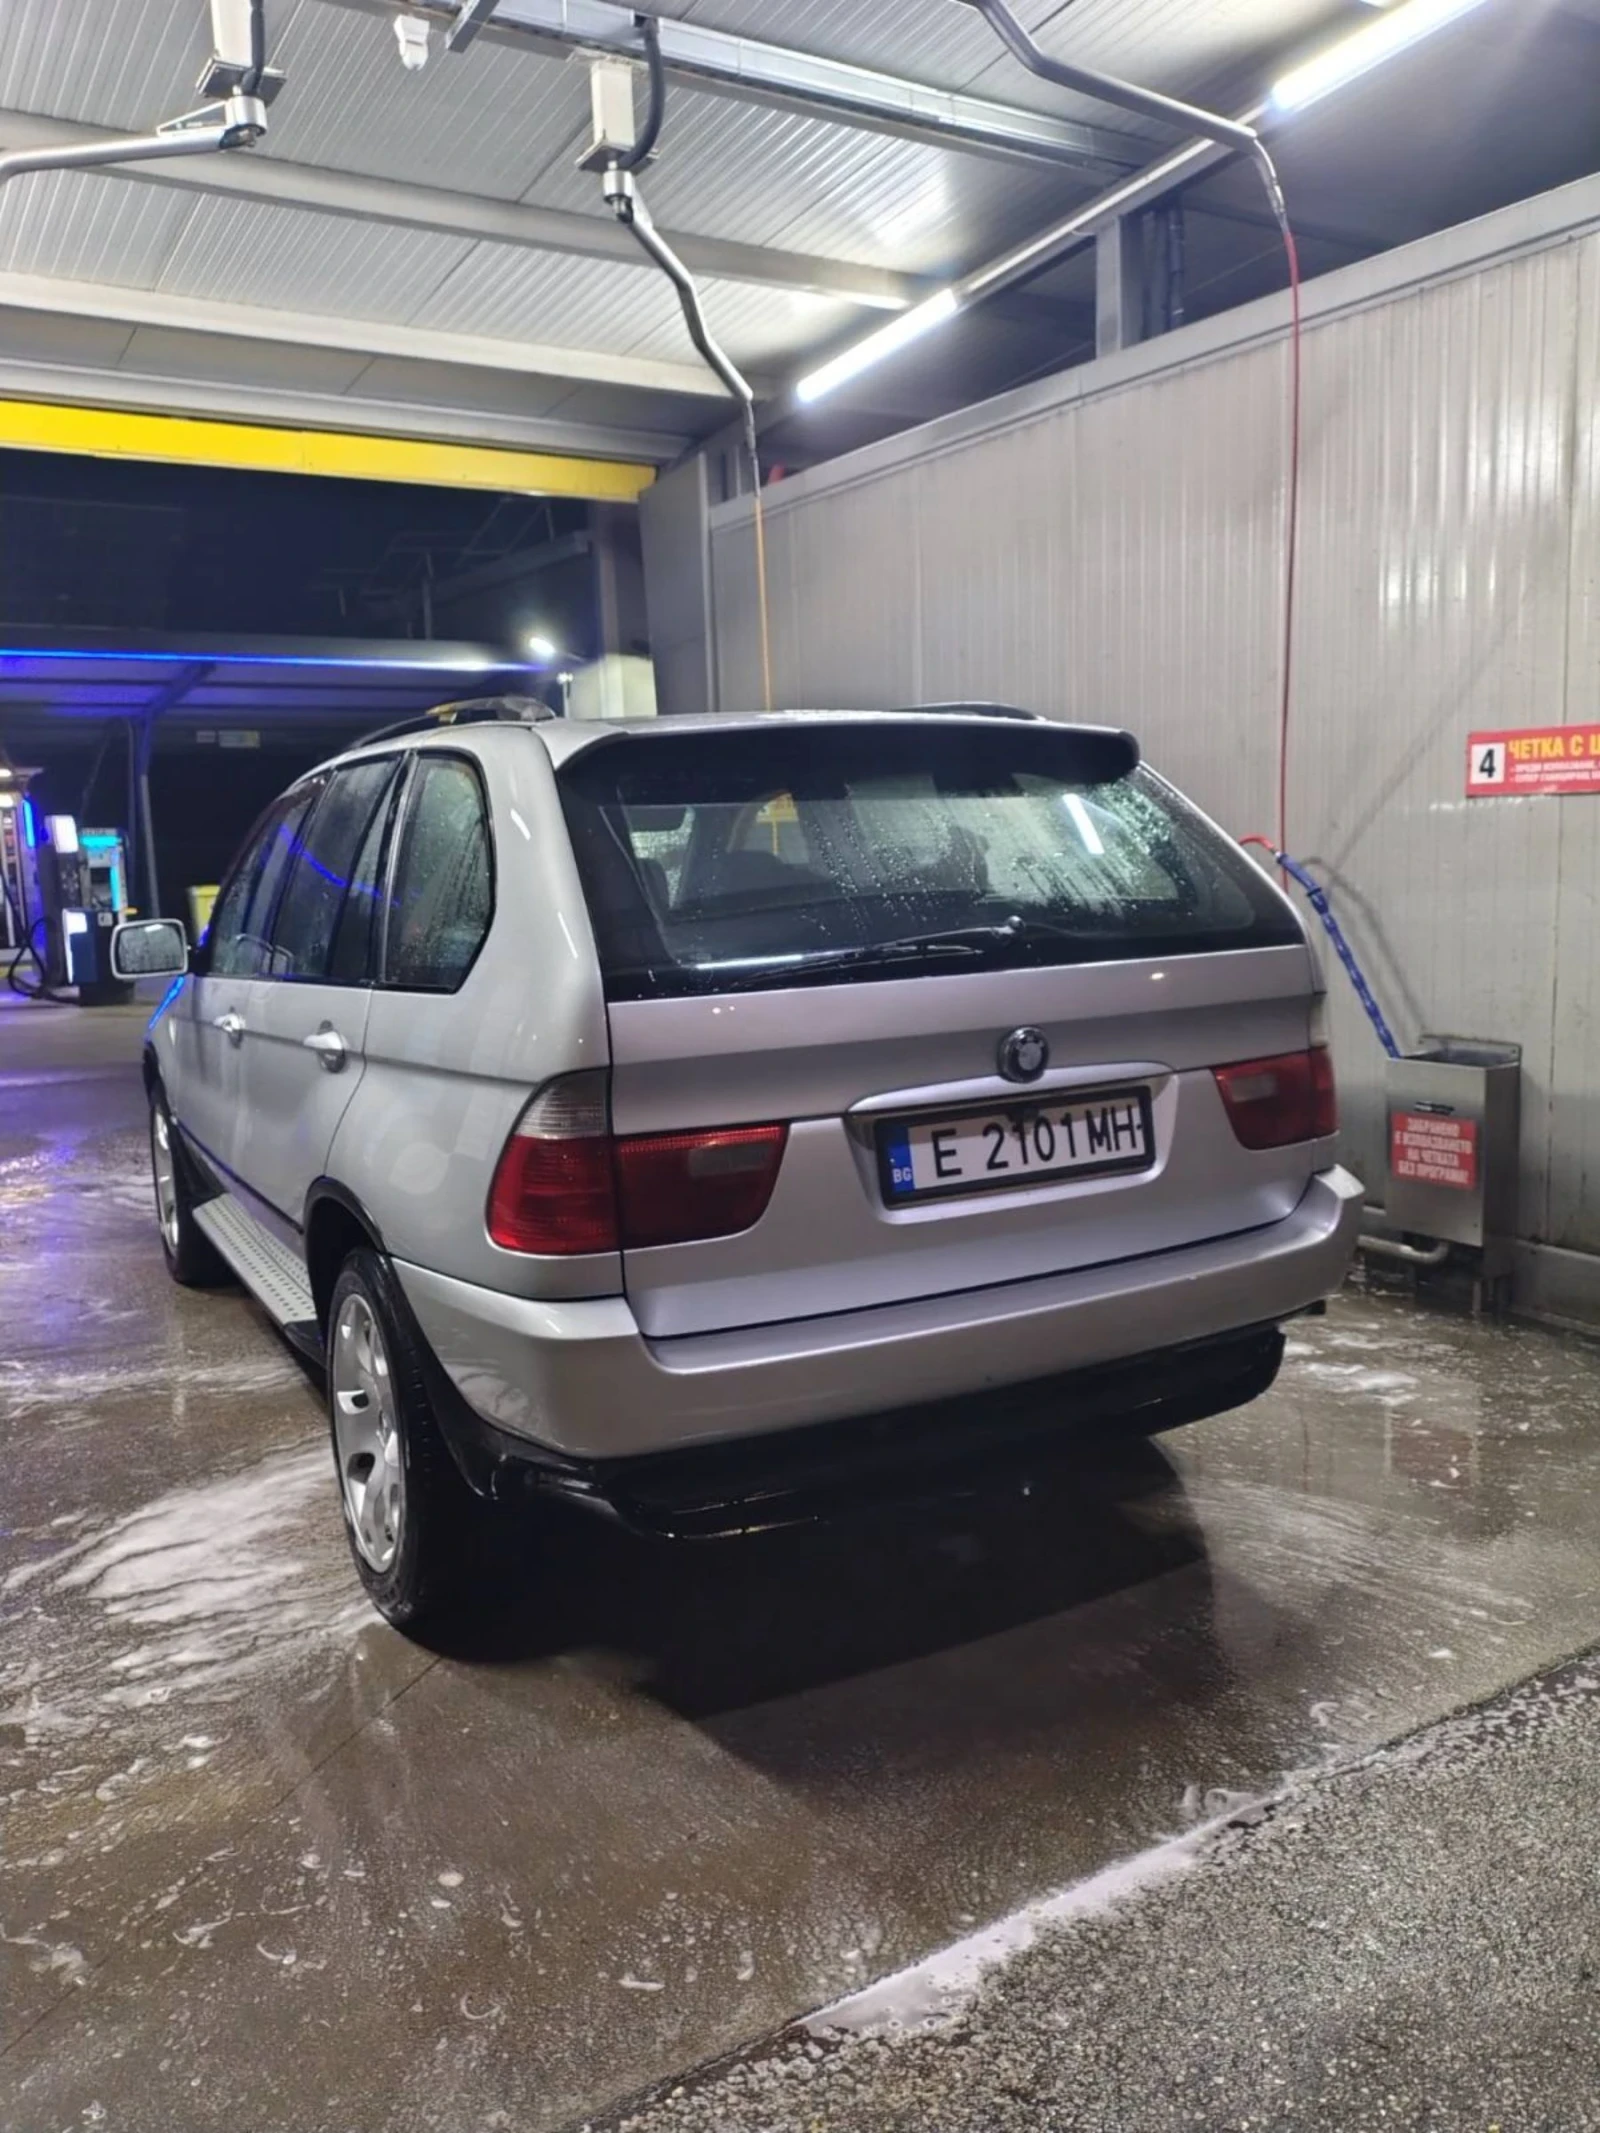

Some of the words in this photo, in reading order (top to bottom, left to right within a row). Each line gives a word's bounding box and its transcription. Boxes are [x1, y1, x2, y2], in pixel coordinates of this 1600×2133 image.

[1508, 735, 1564, 759] ЧЕТКА
[1570, 734, 1584, 757] С
[1479, 748, 1496, 778] 4
[931, 1128, 963, 1178] E
[982, 1112, 1077, 1171] 2101
[1086, 1104, 1137, 1155] MH
[892, 1167, 913, 1184] BG
